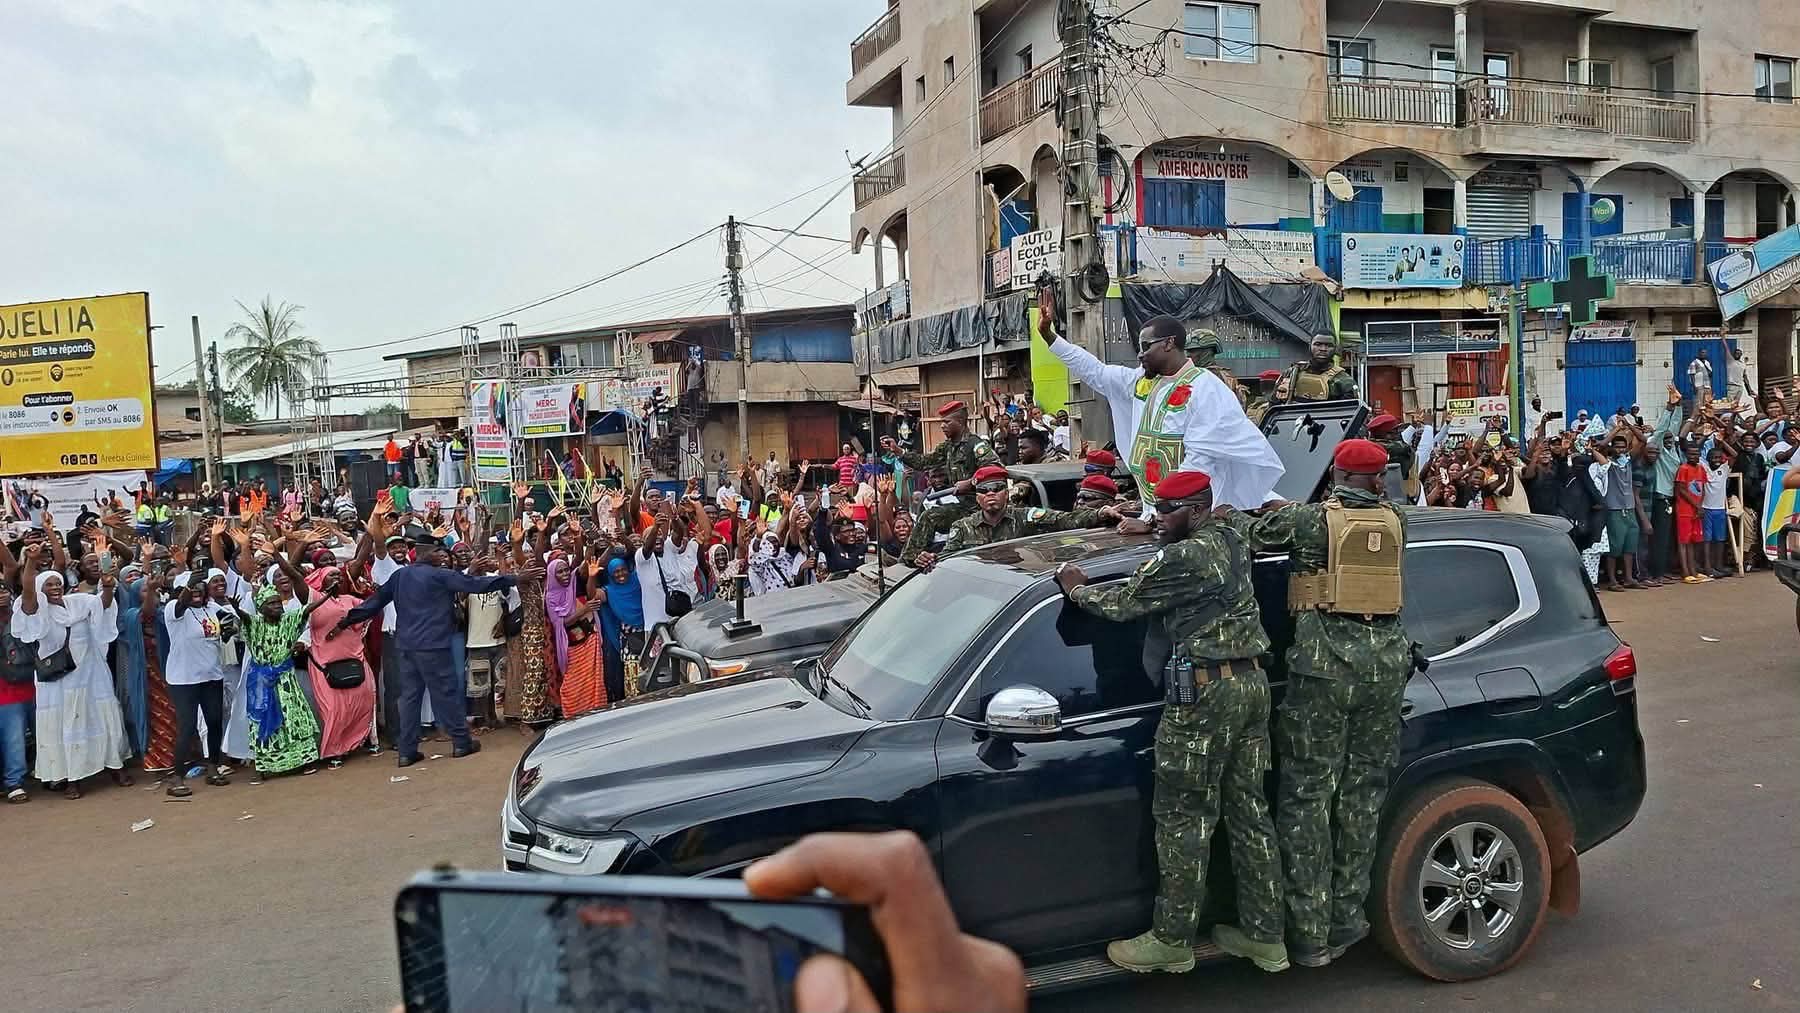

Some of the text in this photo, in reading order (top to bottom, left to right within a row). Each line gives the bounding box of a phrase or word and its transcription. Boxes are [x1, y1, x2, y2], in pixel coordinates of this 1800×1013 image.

[1153, 148, 1251, 162] WELCOME TO THE
[1021, 230, 1053, 248] AUTO
[1017, 242, 1058, 261] ECOLE
[1025, 257, 1049, 271] CFA
[1013, 273, 1035, 286] TEL
[32, 345, 48, 357] Elle
[49, 345, 58, 355] te
[107, 403, 118, 412] OK
[536, 398, 557, 408] MERCI
[1479, 399, 1507, 412] ria
[97, 416, 112, 425] SMS
[123, 414, 141, 423] 8086
[476, 423, 503, 435] MERCI
